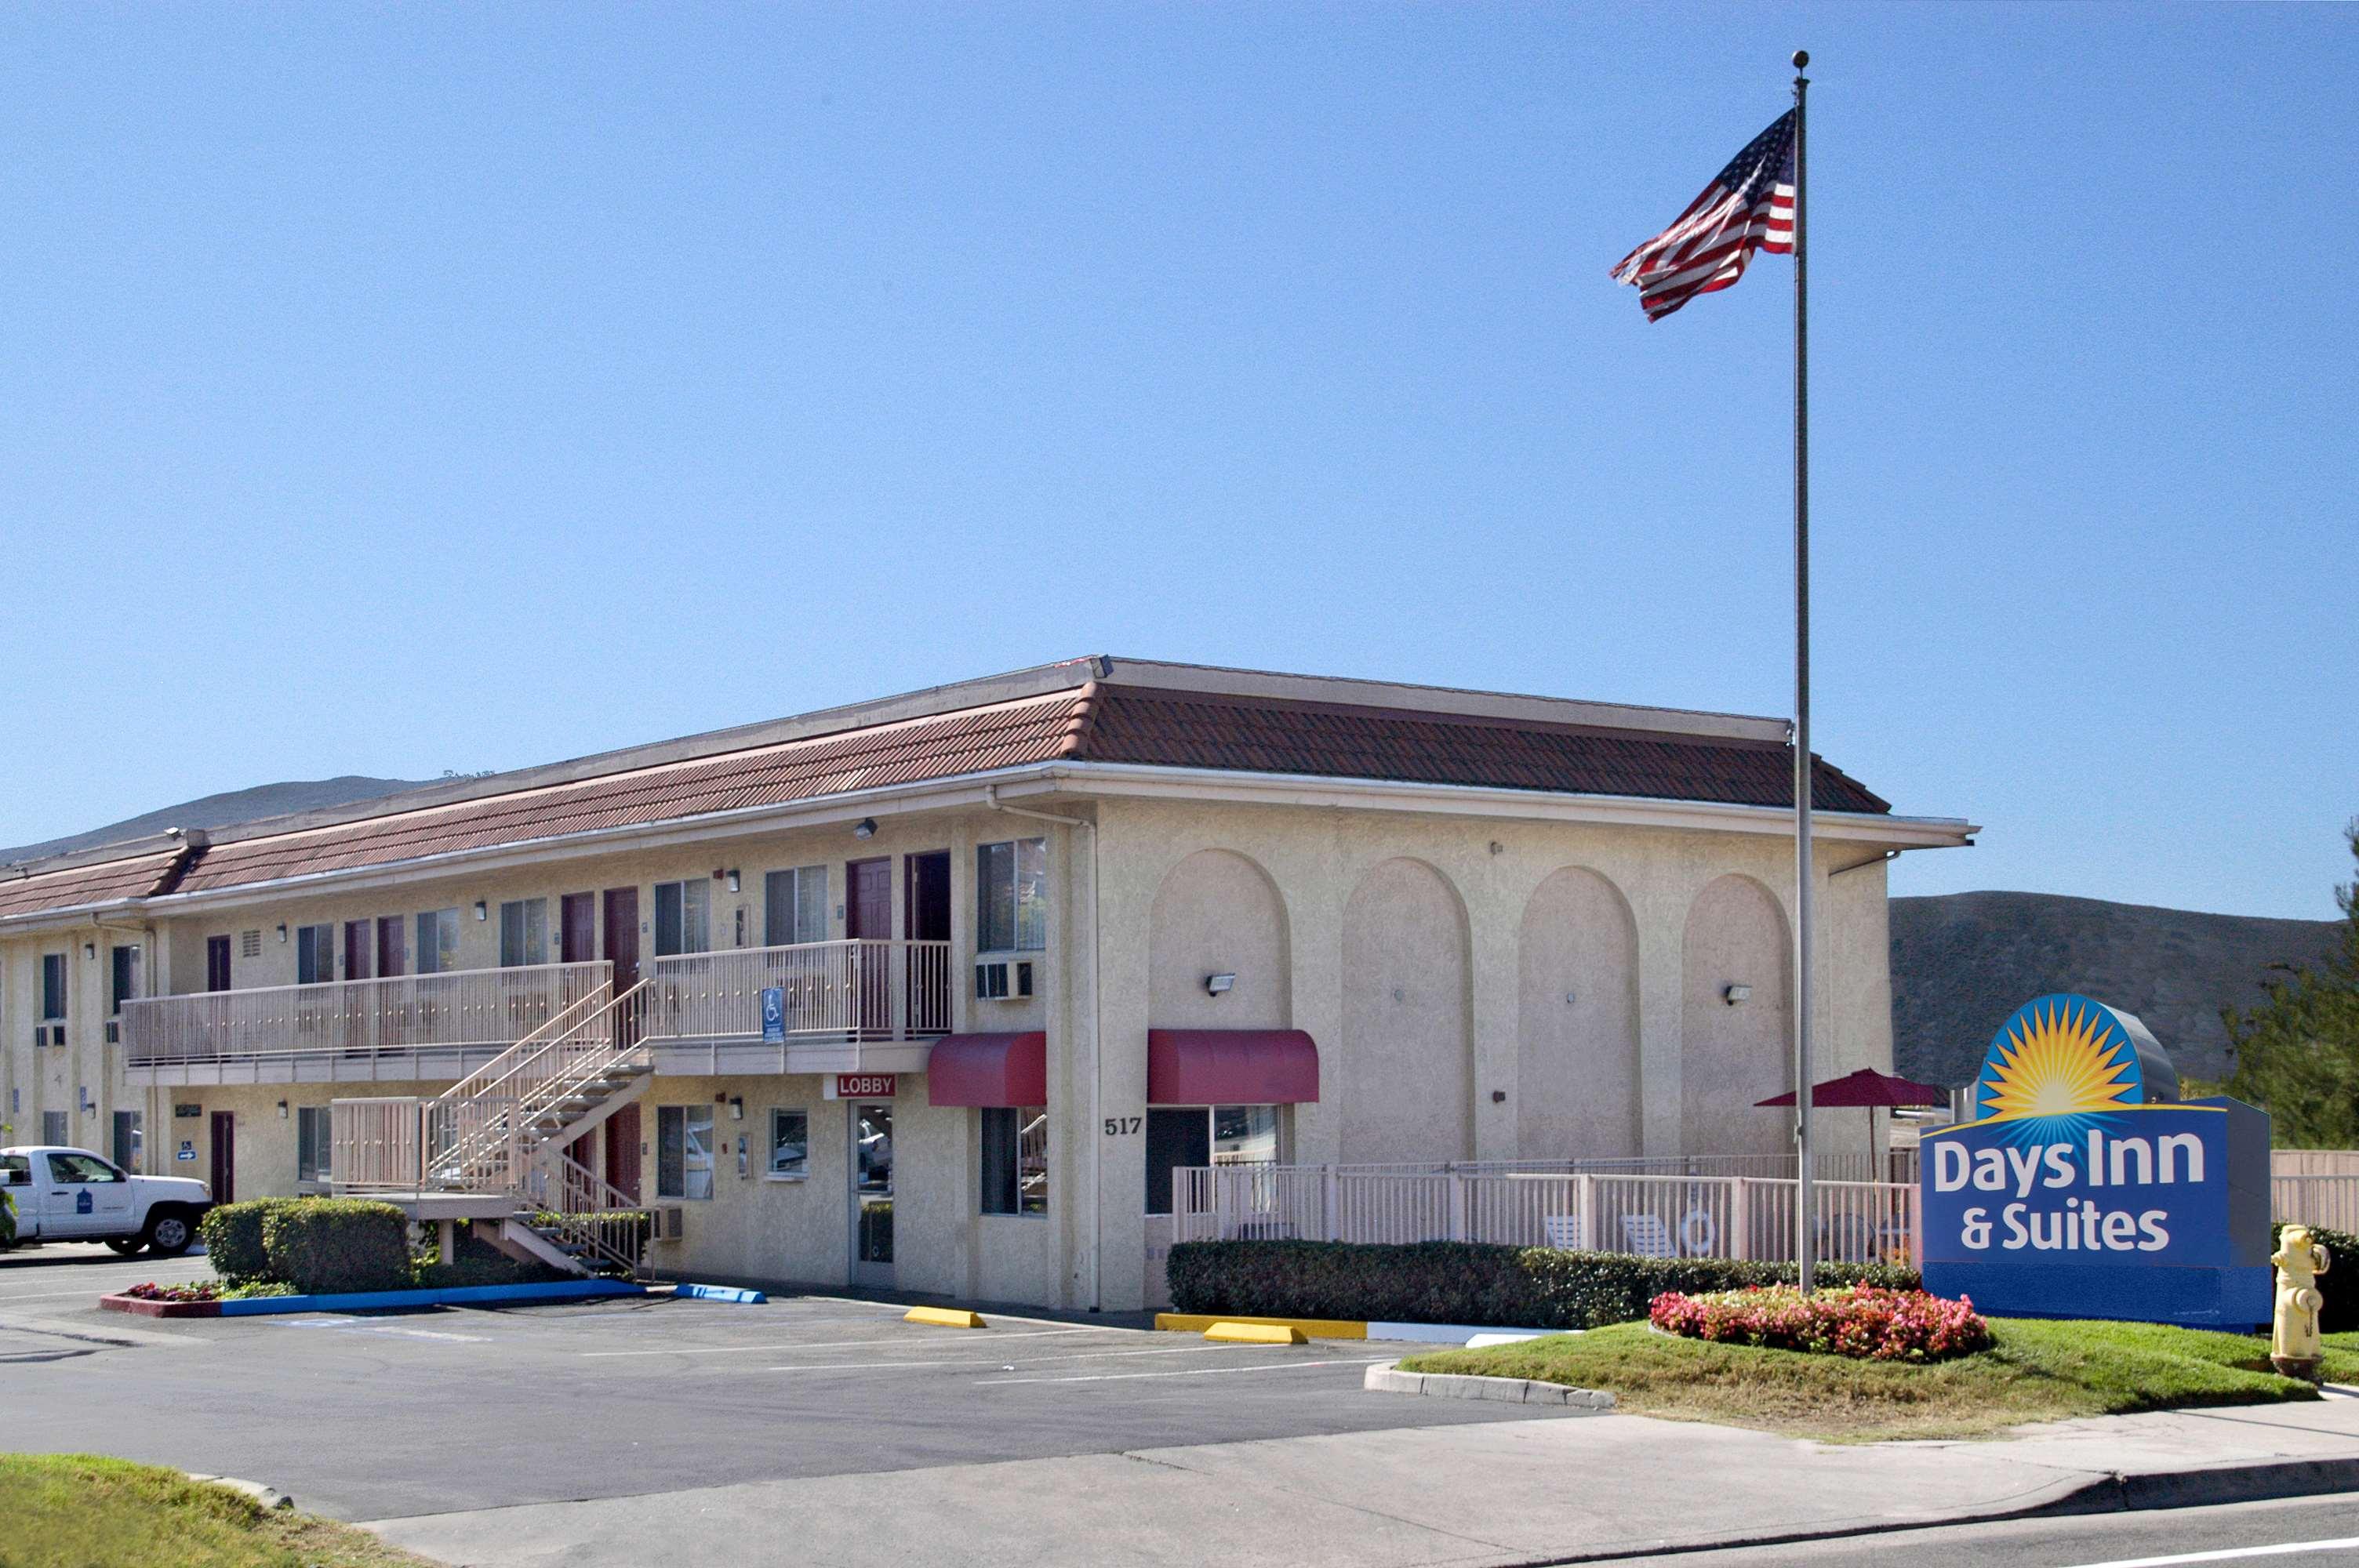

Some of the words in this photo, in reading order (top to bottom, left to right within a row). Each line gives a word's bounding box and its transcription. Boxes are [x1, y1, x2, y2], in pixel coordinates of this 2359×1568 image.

[840, 1077, 892, 1093] LOBBY
[1105, 1116, 1143, 1136] 517
[1934, 1141, 2076, 1199] Days
[2088, 1129, 2205, 1187] Inn
[1961, 1207, 1993, 1250] &
[2002, 1197, 2170, 1252] Suites
